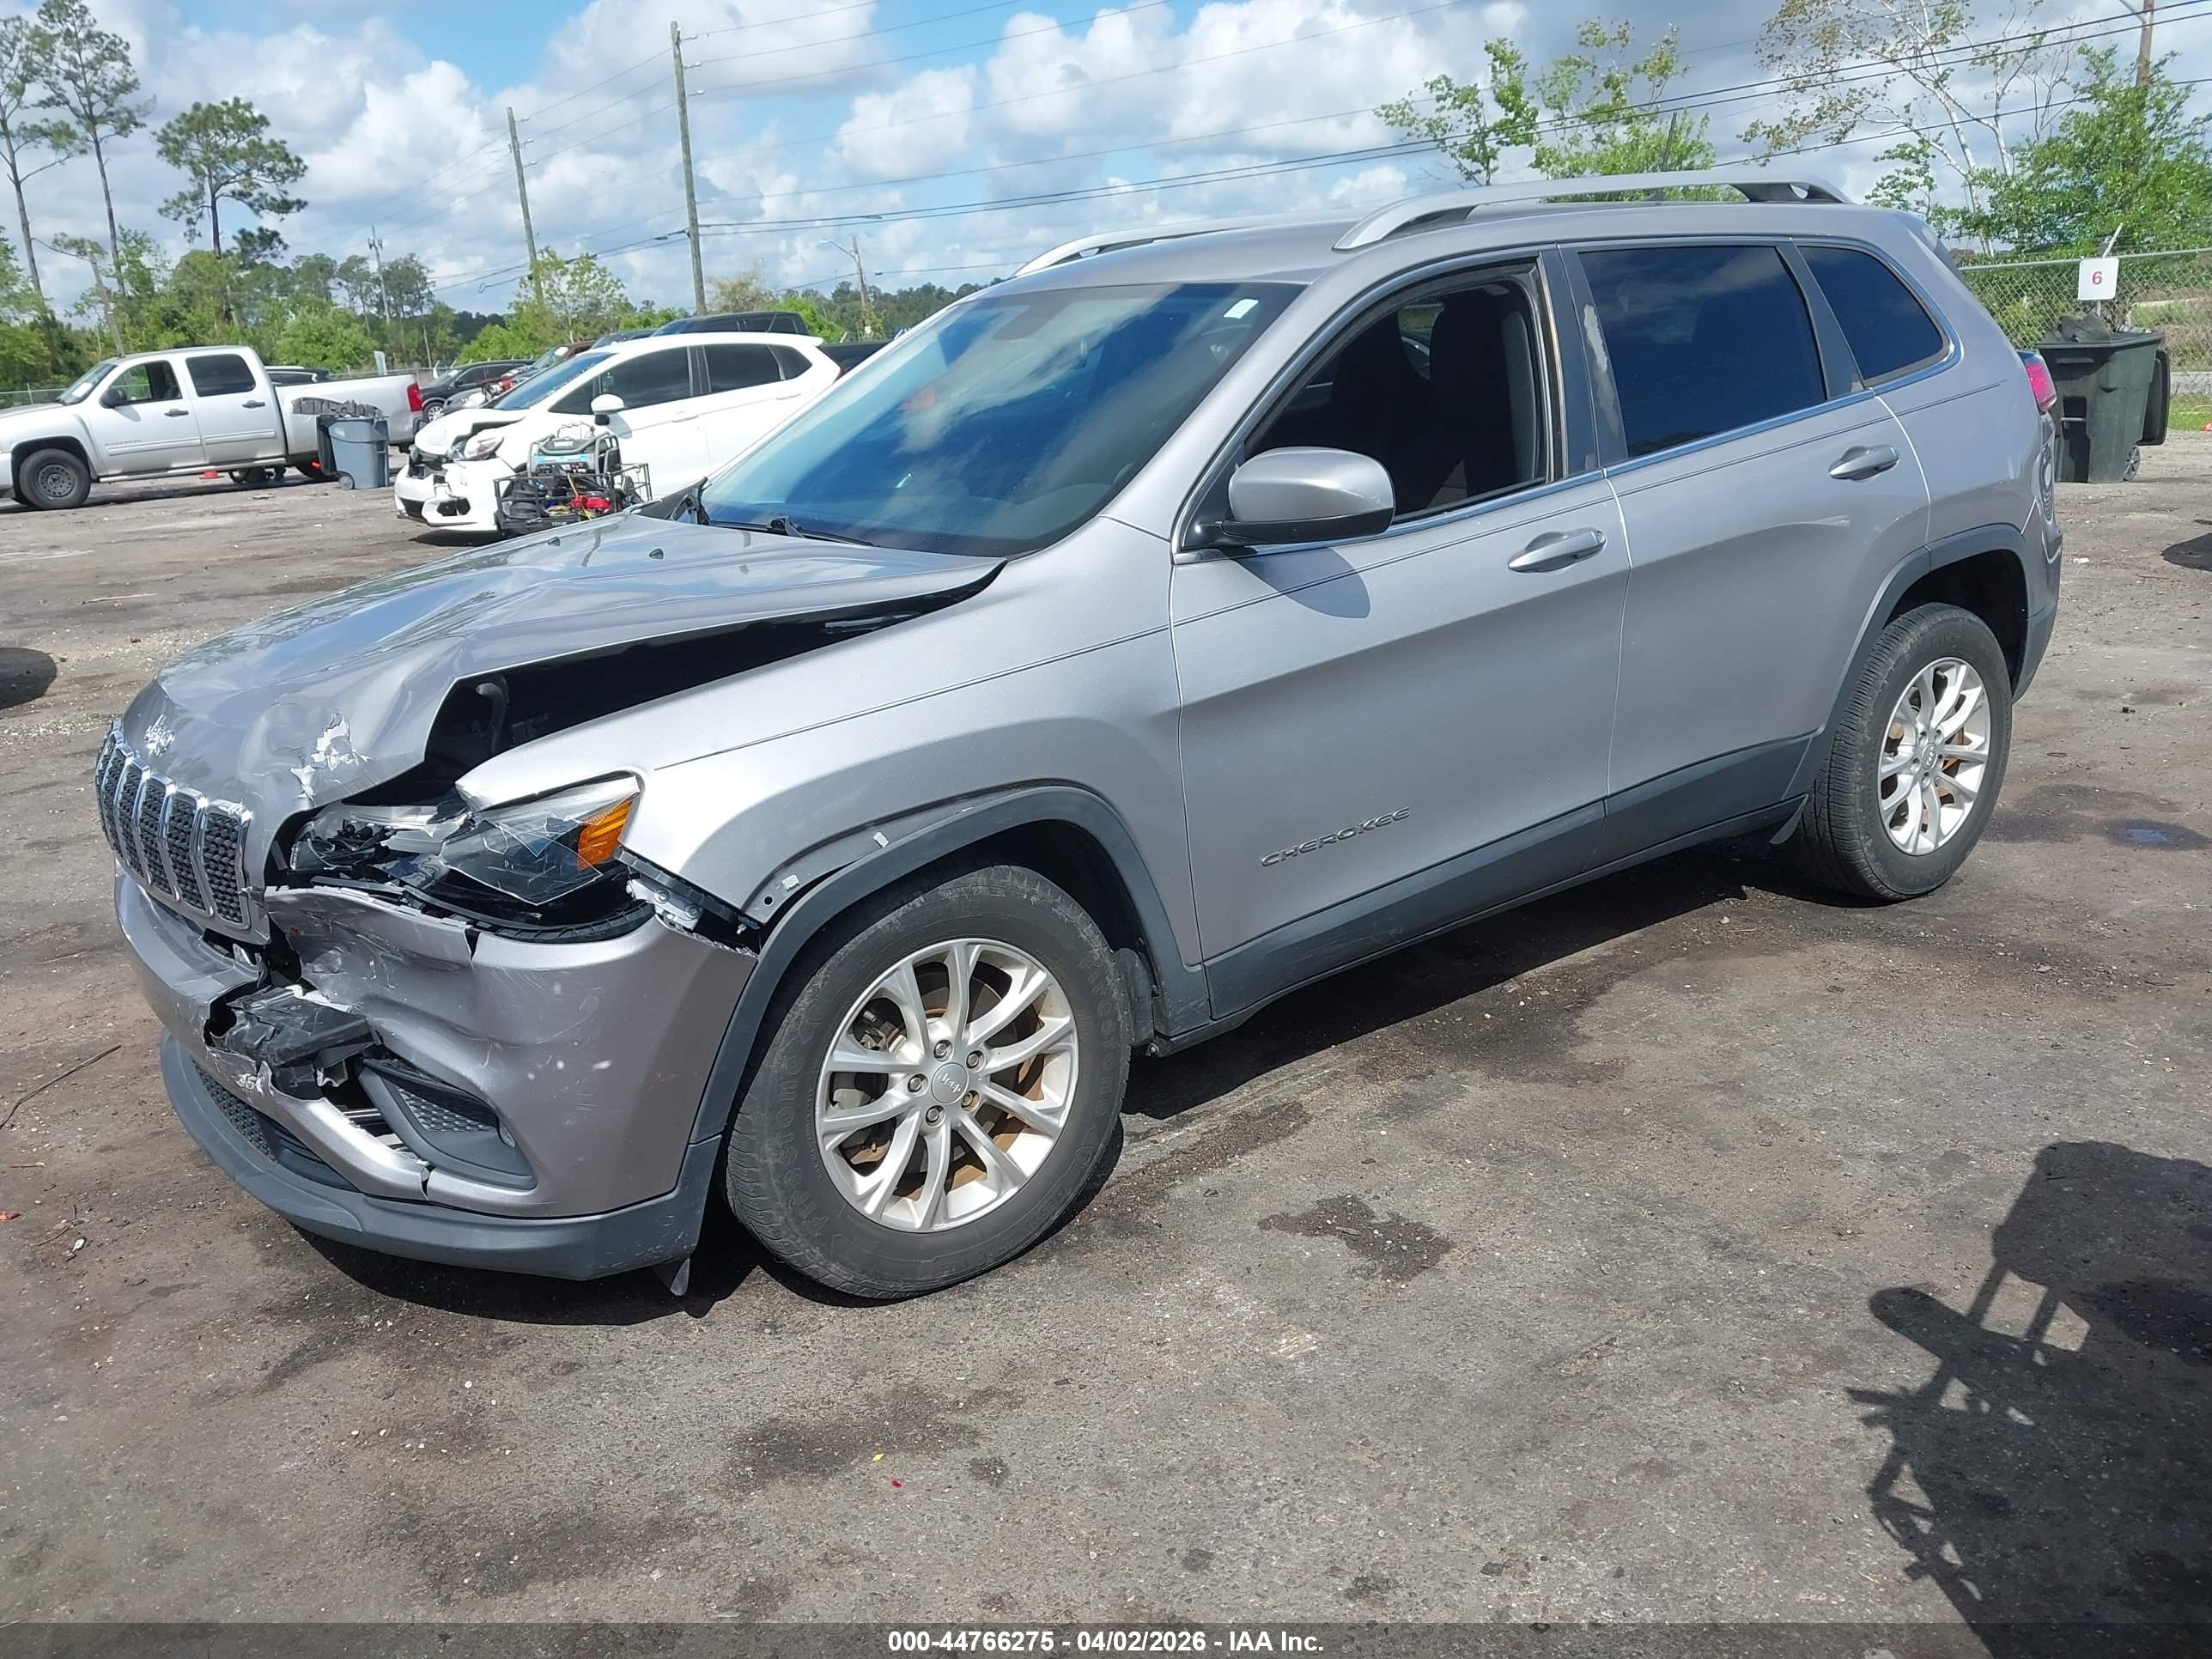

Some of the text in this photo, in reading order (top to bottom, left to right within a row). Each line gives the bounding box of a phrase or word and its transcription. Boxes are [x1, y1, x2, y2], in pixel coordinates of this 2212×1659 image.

[2092, 270, 2103, 285] 6
[1261, 806, 1410, 867] CHEROKEE
[938, 1073, 962, 1093] Jeep
